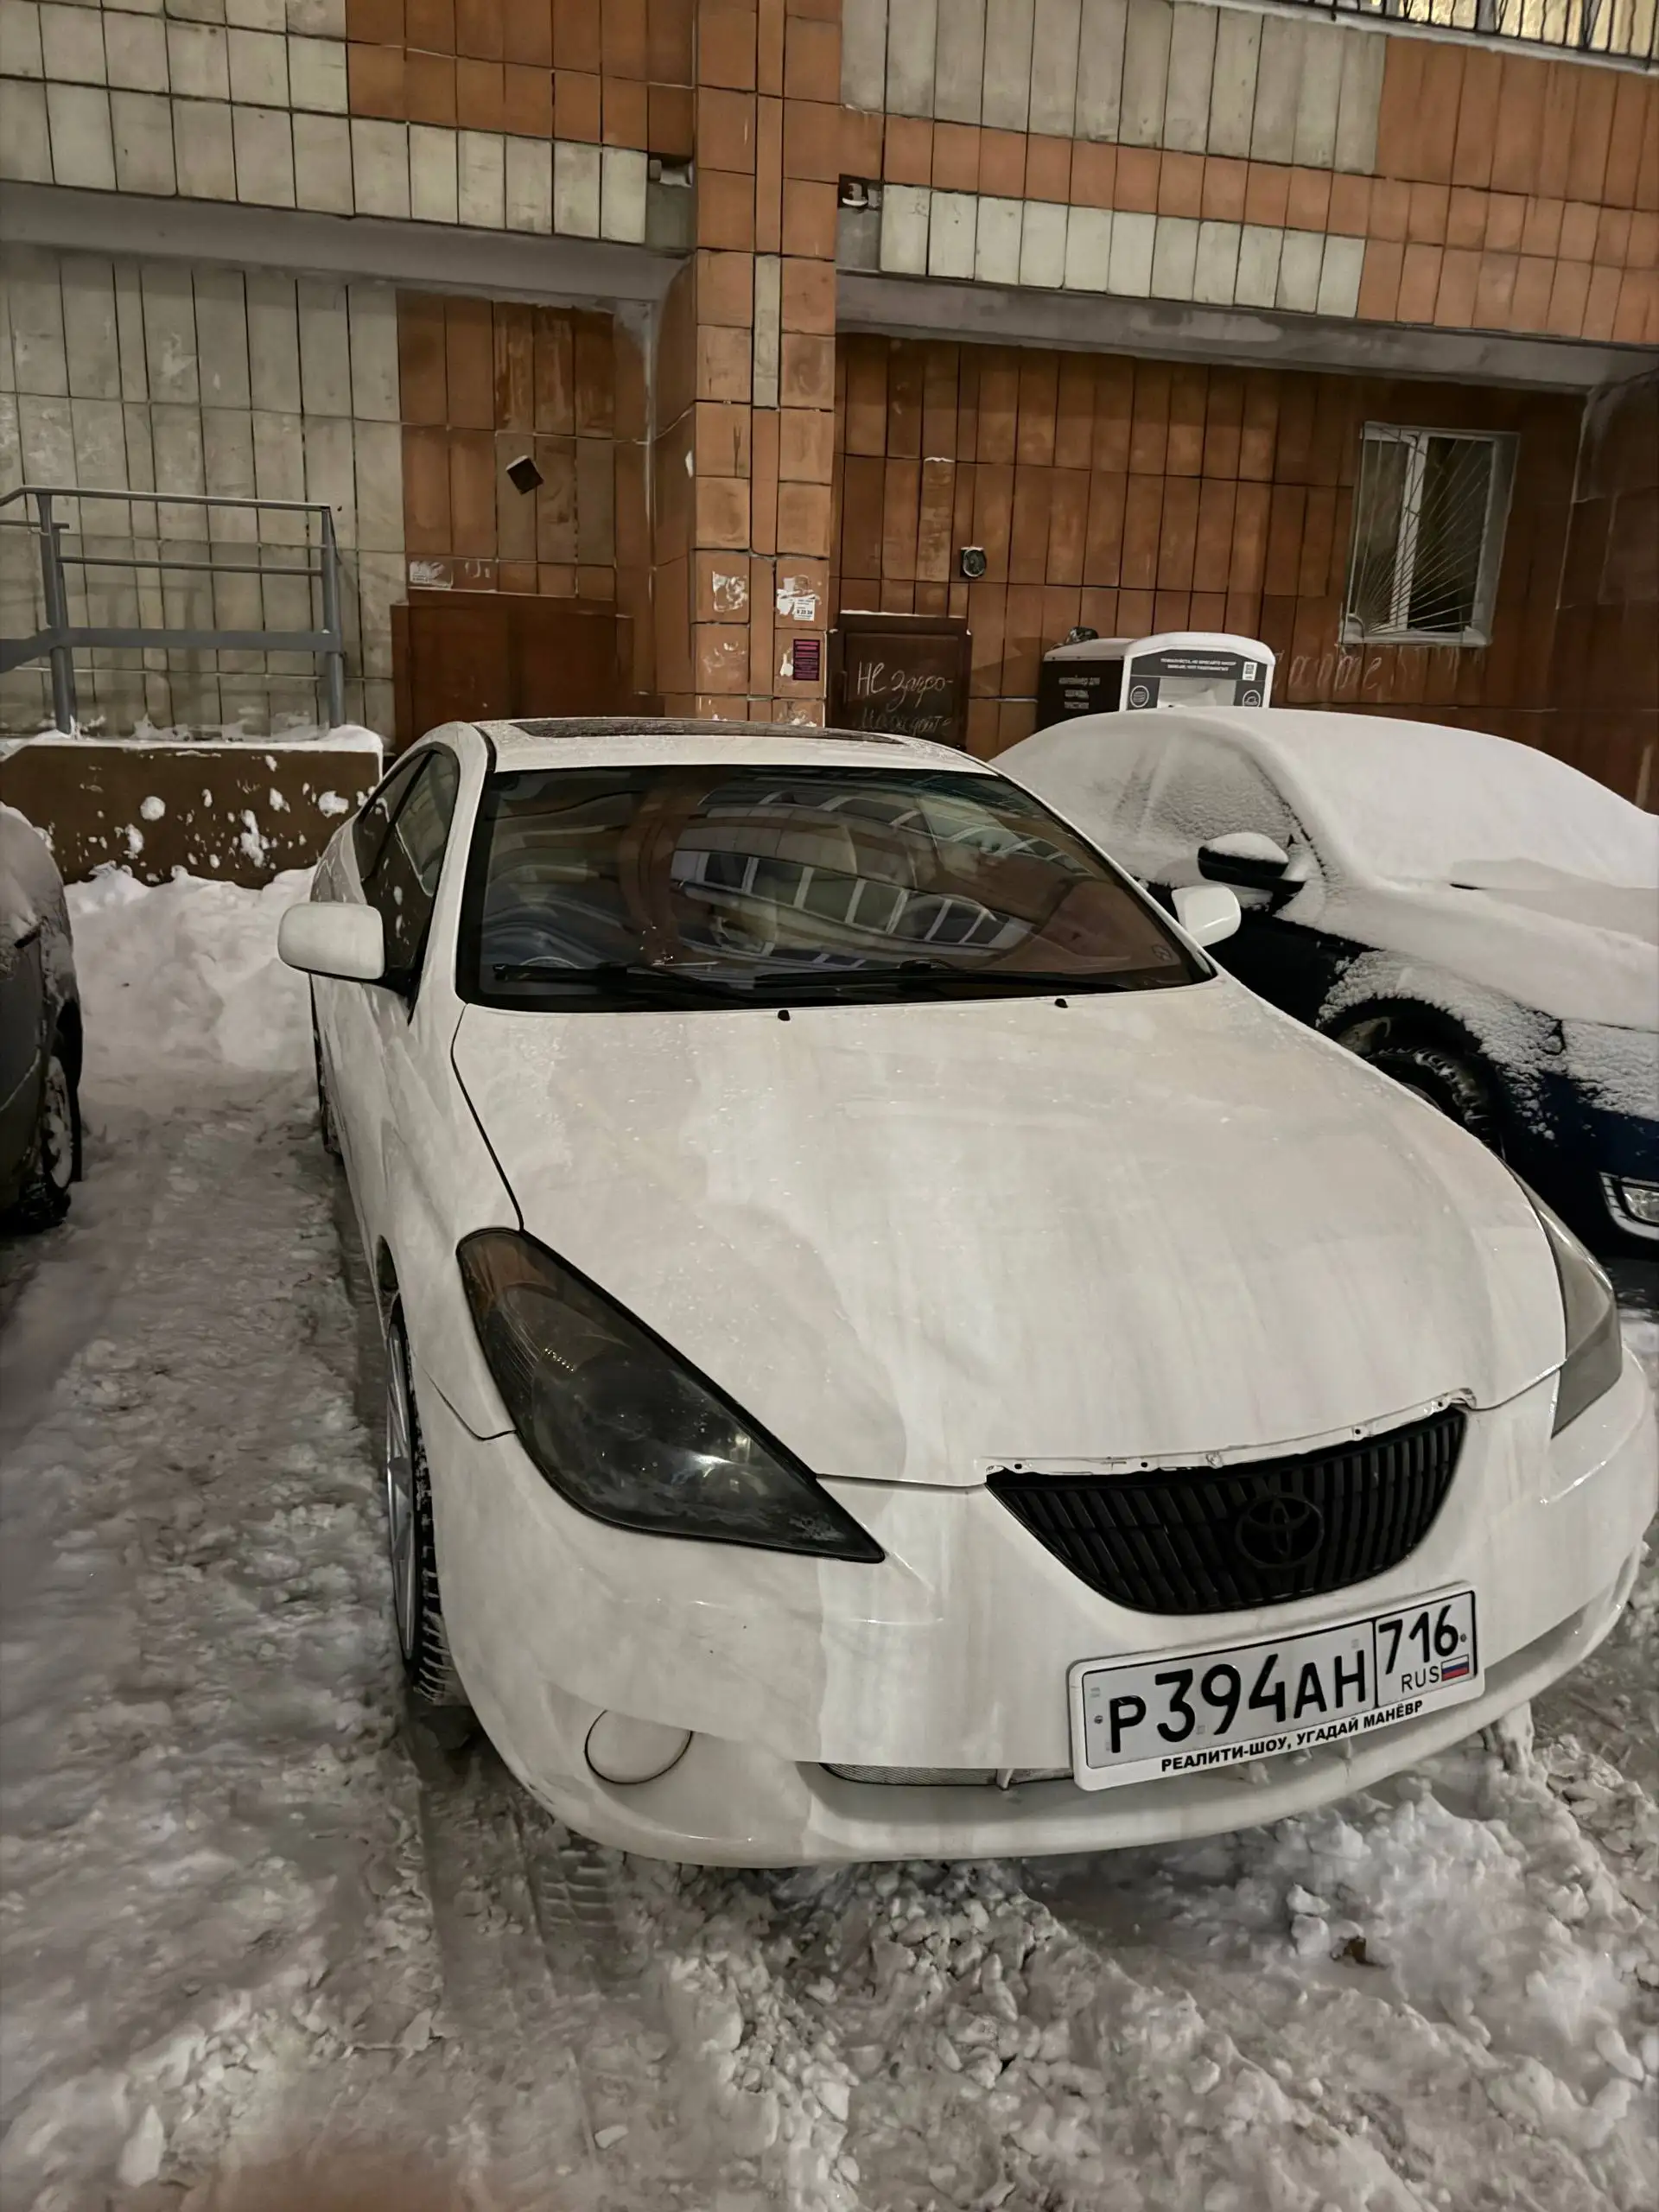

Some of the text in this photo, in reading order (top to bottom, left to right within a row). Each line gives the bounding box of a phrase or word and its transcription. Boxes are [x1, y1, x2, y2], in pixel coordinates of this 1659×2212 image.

[1109, 1605, 1459, 1753] Р394АН 716
[1401, 1664, 1440, 1693] RUS
[1161, 1700, 1423, 1771] РЕАЛИТИ-ШОУ, УГАДАЙ МАНЁВР
